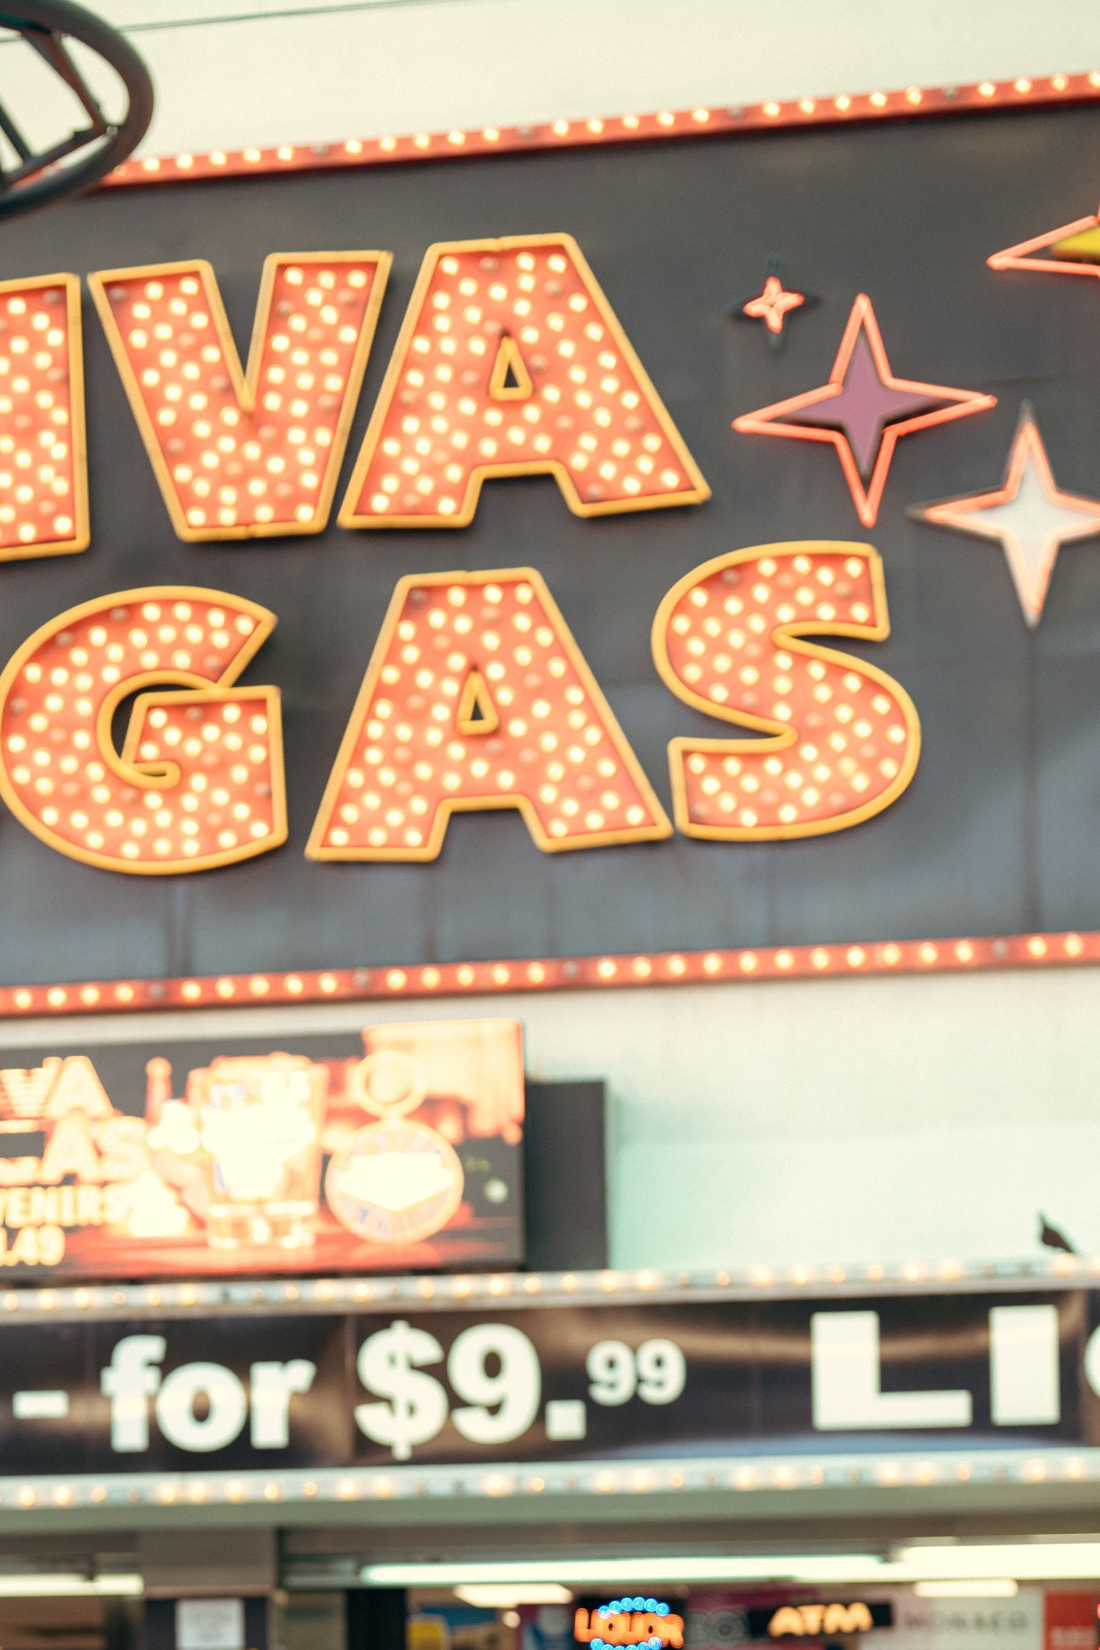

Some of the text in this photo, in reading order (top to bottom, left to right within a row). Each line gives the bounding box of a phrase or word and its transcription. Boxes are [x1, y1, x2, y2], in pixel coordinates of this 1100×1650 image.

[100, 1334, 317, 1454] for
[354, 1320, 687, 1461] $9.99
[810, 1304, 1100, 1431] LI
[767, 1602, 873, 1637] ATM
